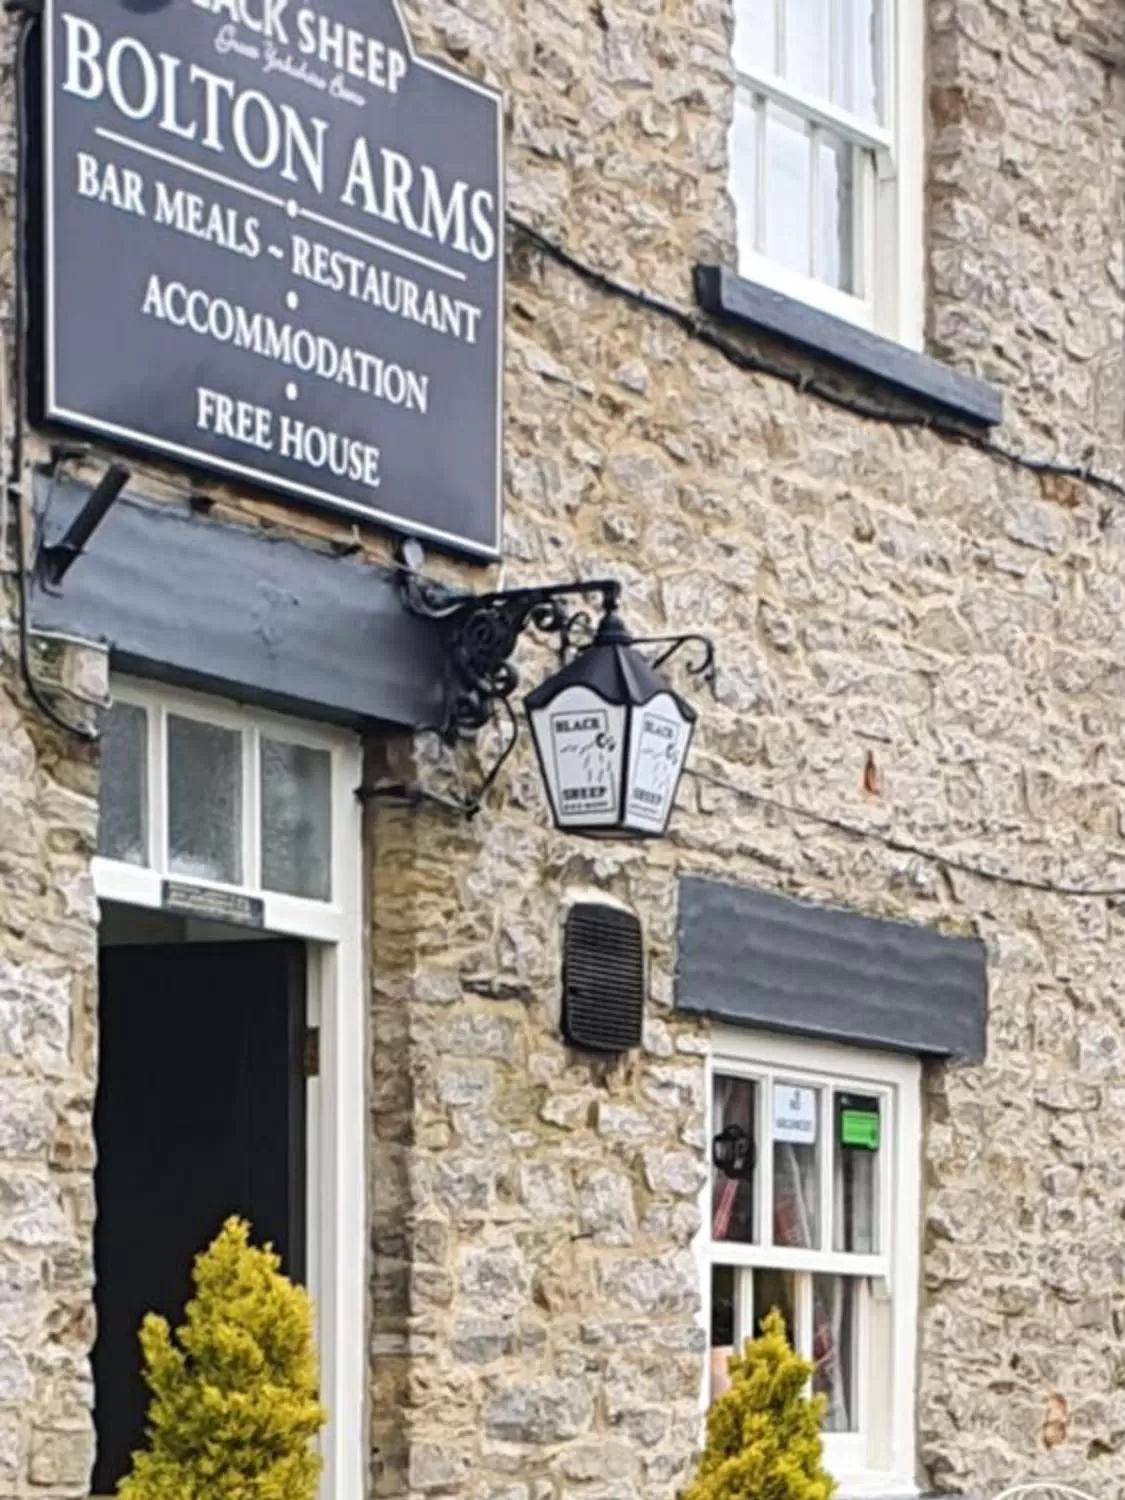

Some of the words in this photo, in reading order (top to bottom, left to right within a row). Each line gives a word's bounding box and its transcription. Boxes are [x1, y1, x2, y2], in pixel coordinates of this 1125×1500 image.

[297, 9, 407, 94] SHEEP
[61, 13, 328, 193] BOLTON
[341, 137, 496, 262] ARMS
[77, 152, 145, 216] BAR
[154, 182, 261, 257] MEALS
[291, 234, 482, 343] RESTAURANT
[141, 274, 429, 413] ACCOMMODATION
[196, 387, 272, 451] FREE
[279, 415, 381, 488] HOUSE
[555, 717, 599, 733] BLACK
[562, 785, 607, 801] SHEEP
